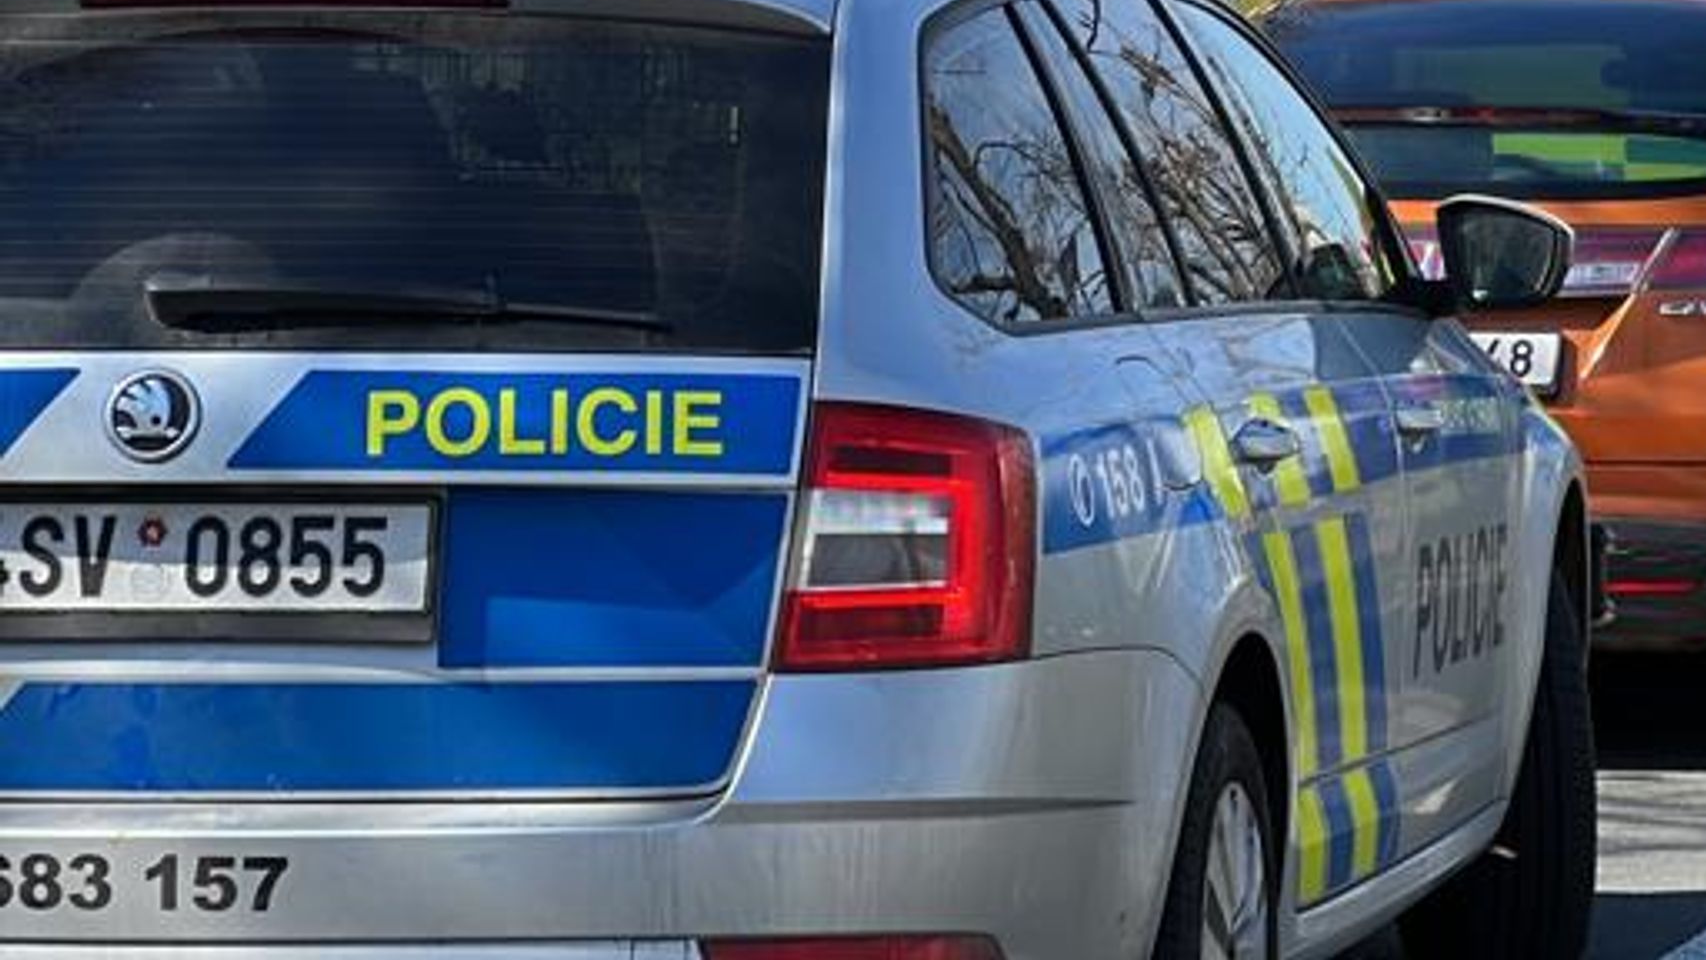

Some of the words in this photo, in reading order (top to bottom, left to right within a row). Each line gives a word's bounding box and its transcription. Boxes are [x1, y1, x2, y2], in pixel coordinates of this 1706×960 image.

[366, 387, 723, 457] POLICIE
[1096, 443, 1145, 519] 158
[0, 515, 117, 598] SV
[185, 515, 388, 598] 0855
[1414, 522, 1507, 679] POLICIE
[145, 853, 289, 912] 157
